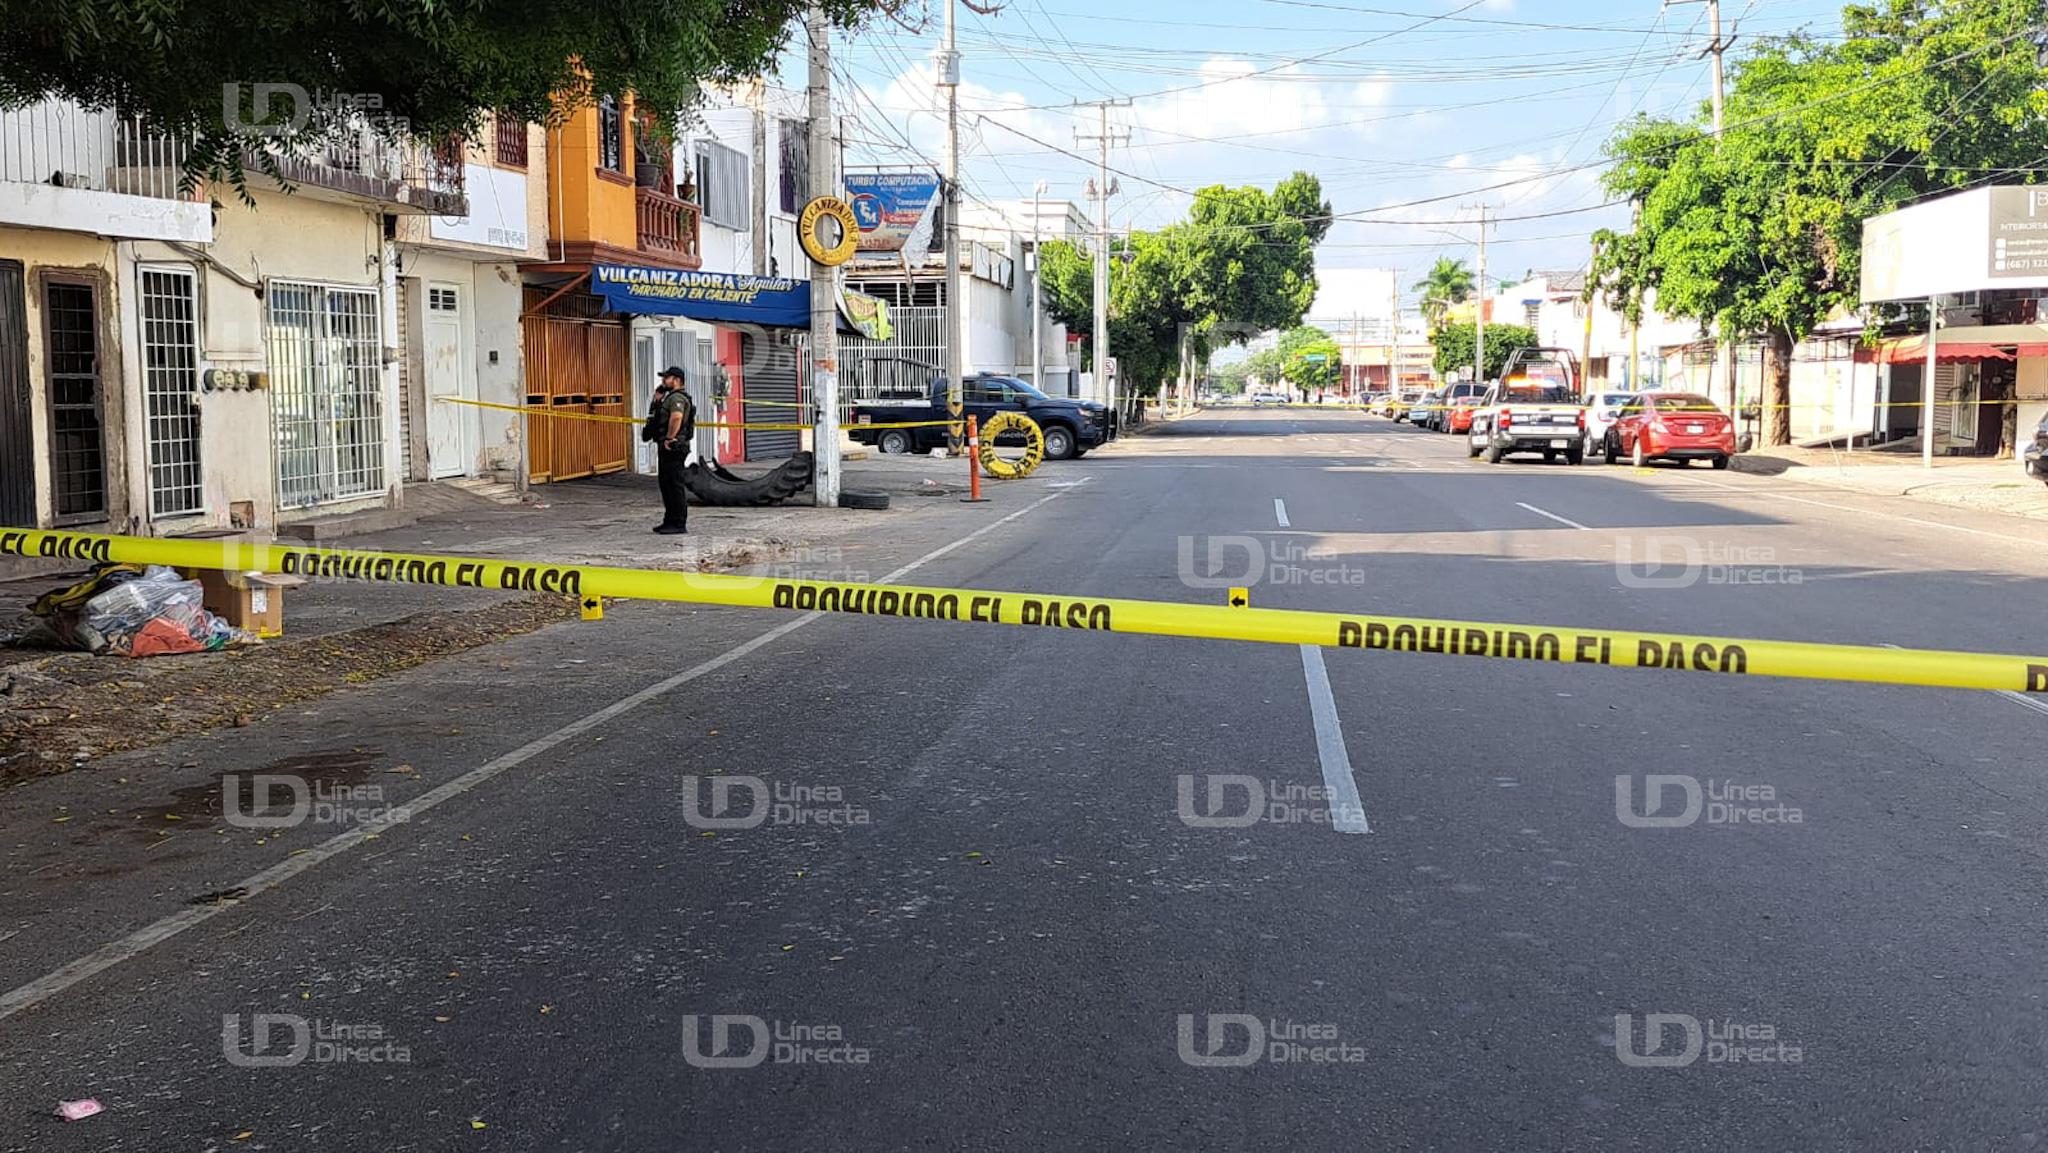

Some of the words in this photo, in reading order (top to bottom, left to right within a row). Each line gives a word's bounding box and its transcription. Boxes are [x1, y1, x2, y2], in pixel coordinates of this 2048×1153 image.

[847, 176, 876, 186] TURBO
[598, 266, 735, 289] VULCANIZADORA
[629, 284, 685, 299] PARCHADO
[688, 287, 704, 300] EN
[705, 289, 753, 304] CALIENTE
